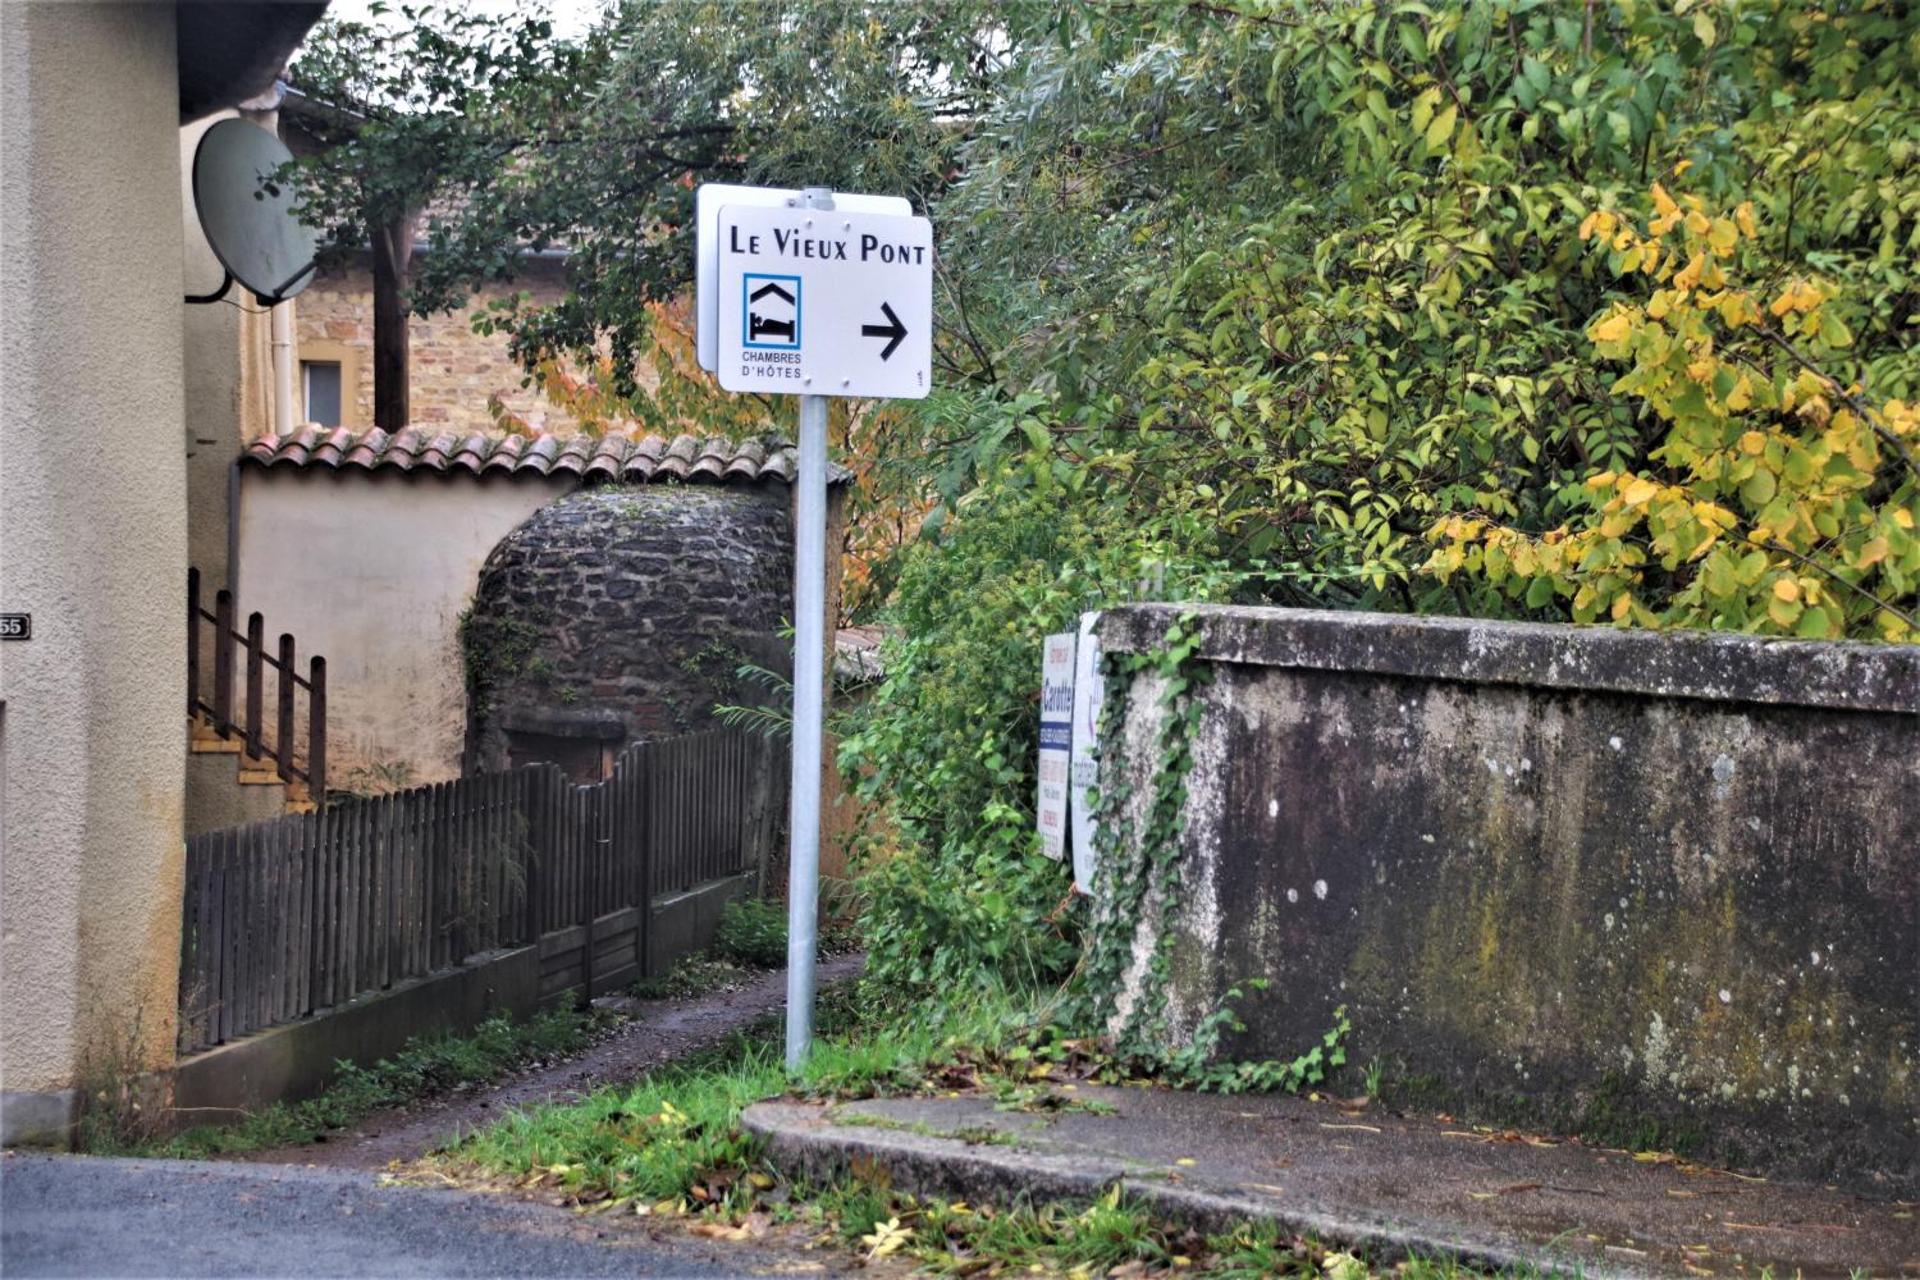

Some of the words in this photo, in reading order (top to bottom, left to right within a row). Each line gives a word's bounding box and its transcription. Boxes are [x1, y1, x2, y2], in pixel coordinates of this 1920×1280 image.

[731, 225, 760, 255] LE
[861, 233, 926, 265] PONT
[742, 351, 801, 364] CHAMBRES
[742, 365, 801, 379] D'HÔTES
